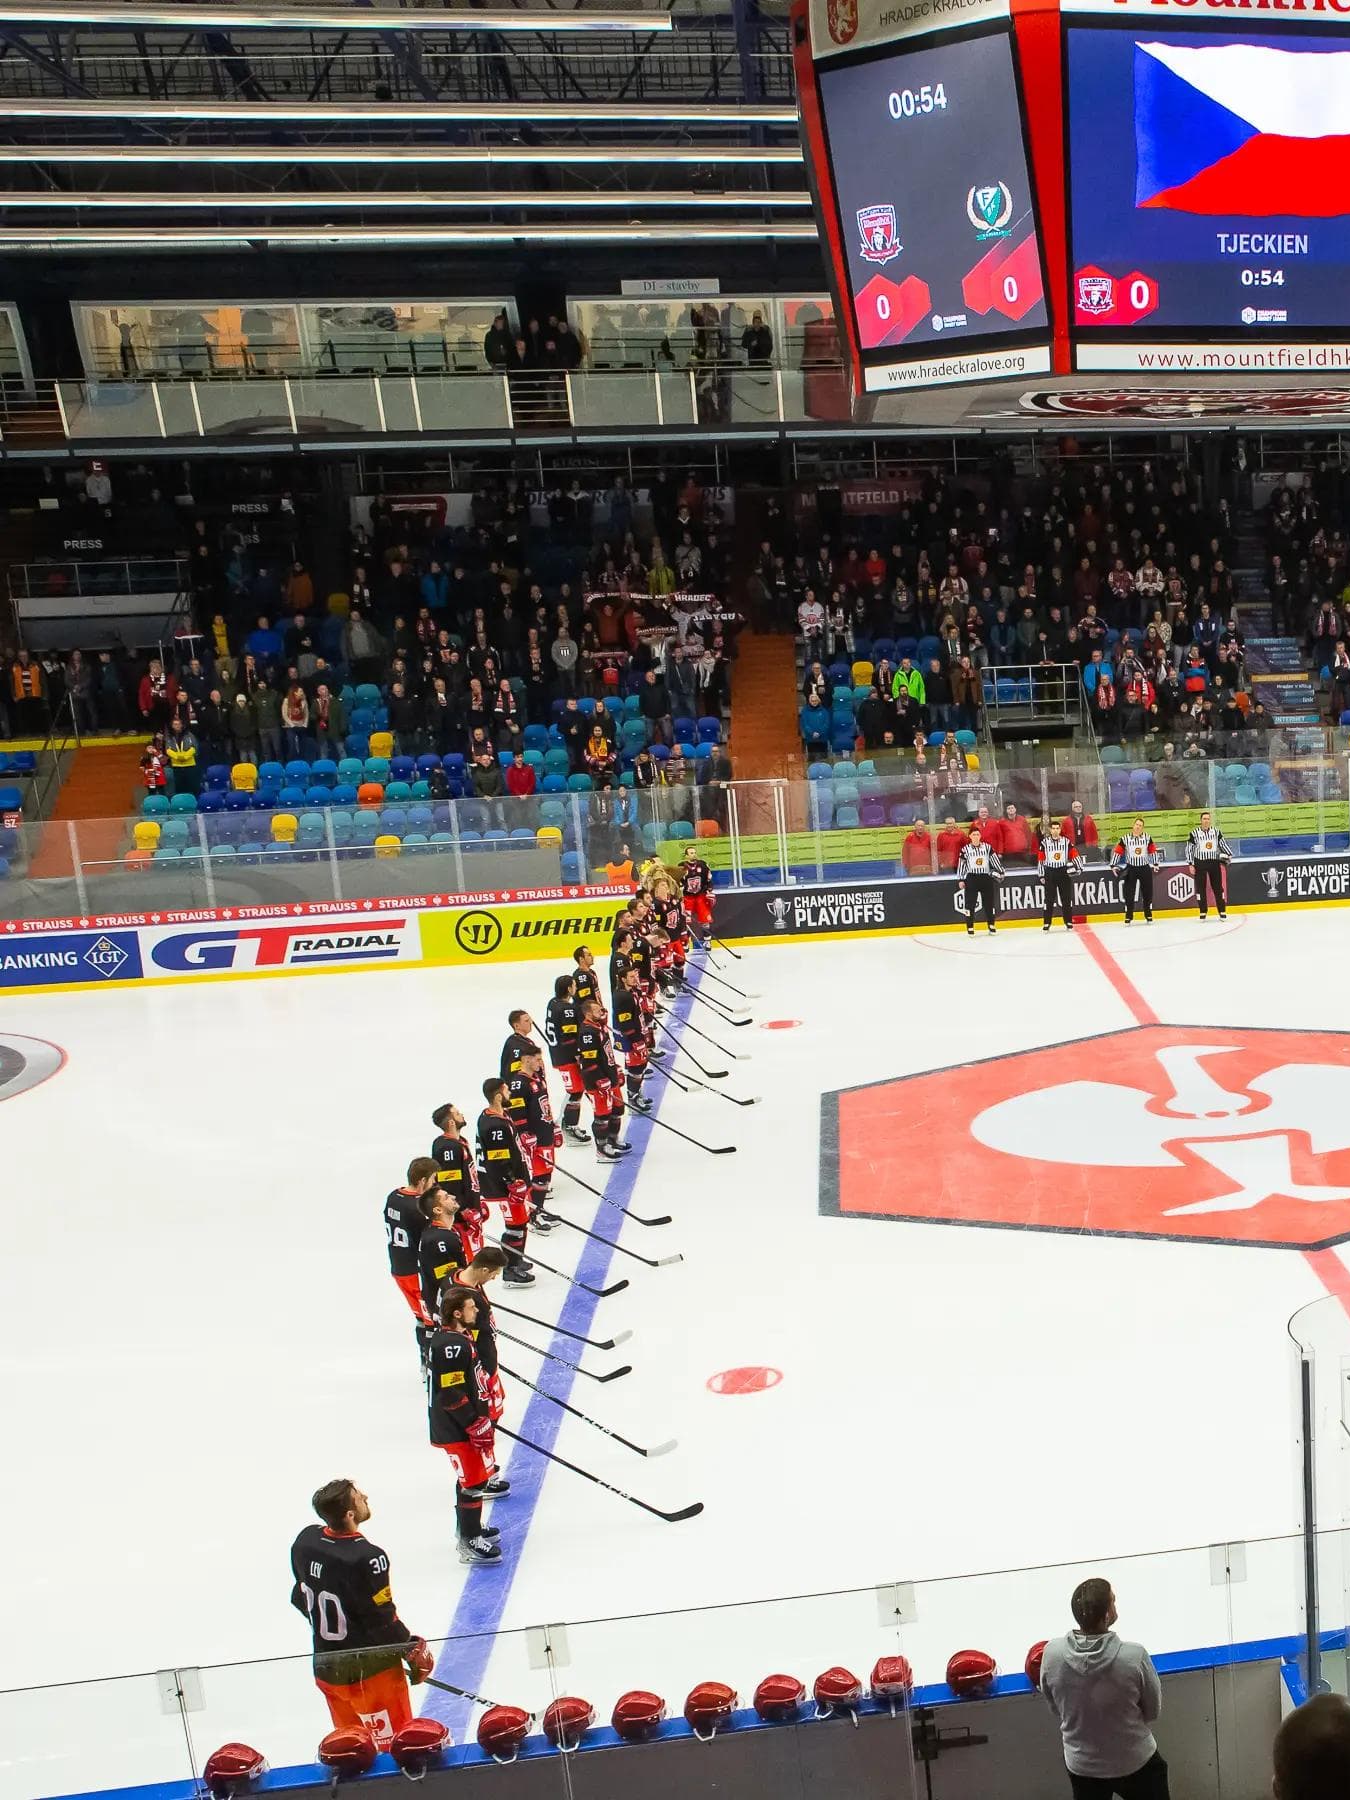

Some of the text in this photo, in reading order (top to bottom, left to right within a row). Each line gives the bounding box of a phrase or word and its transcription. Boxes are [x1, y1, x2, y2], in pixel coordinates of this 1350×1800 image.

[879, 5, 930, 26] HRADEC
[888, 83, 947, 120] 00:54
[1217, 233, 1309, 255] TJECKIEN
[1003, 276, 1018, 302] 0
[1241, 270, 1285, 287] 0:54
[1131, 280, 1149, 310] 0
[877, 294, 890, 320] 0
[887, 355, 1026, 383] www.hradeckralove.org
[231, 503, 269, 513] PRESS
[64, 539, 104, 550] PRESS
[675, 594, 712, 602] HRADEC
[1287, 863, 1350, 878] CHAMPIONS
[1169, 876, 1196, 901] CHL
[22, 884, 631, 931] STRAUSS STRAUSS STRAUSS STRAUSS STRAUSS STRAUSS STRAUSS STRAUSS STRAUSS
[794, 893, 862, 910] CHAMPIONS
[794, 903, 886, 928] PLAYOFFS
[511, 915, 615, 939] WARRI
[151, 926, 294, 972] GT
[293, 933, 401, 952] RADIAL
[93, 949, 122, 964] LGT
[510, 1080, 522, 1090] 23
[491, 1130, 504, 1141] 72
[444, 1150, 454, 1161] 81
[444, 1344, 462, 1360] 67
[369, 1554, 389, 1575] 30
